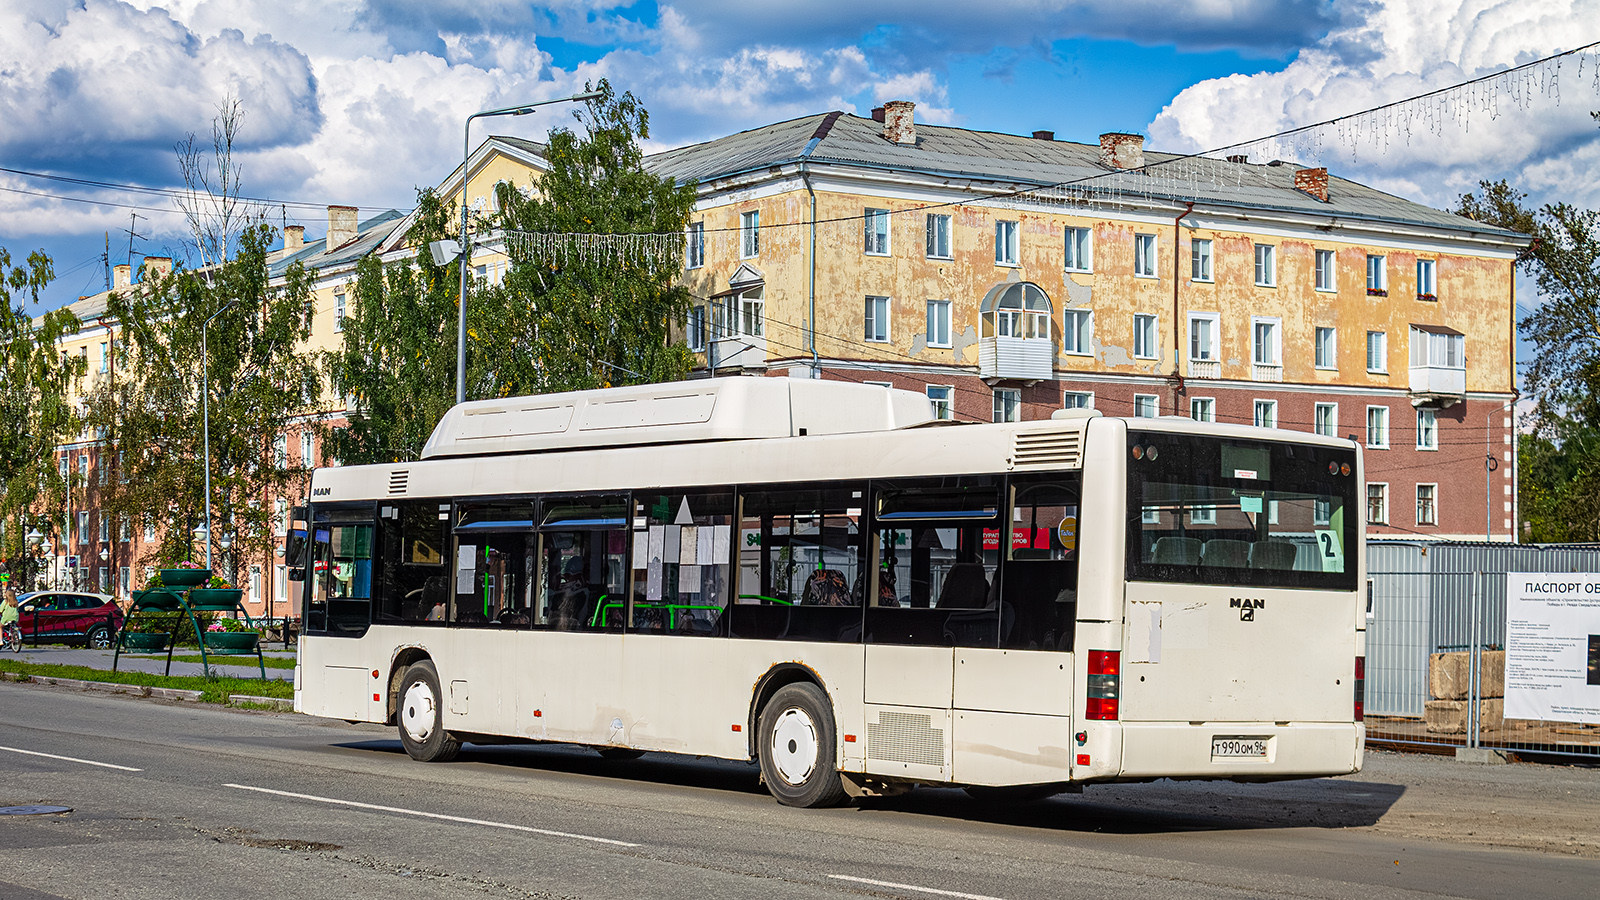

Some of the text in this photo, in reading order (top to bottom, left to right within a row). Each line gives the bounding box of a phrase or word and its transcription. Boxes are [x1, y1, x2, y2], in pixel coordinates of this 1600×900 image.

[313, 487, 331, 496] MAN
[1320, 532, 1336, 558] 2
[1525, 582, 1582, 594] ПАСПОРТ
[1229, 597, 1265, 609] MAN
